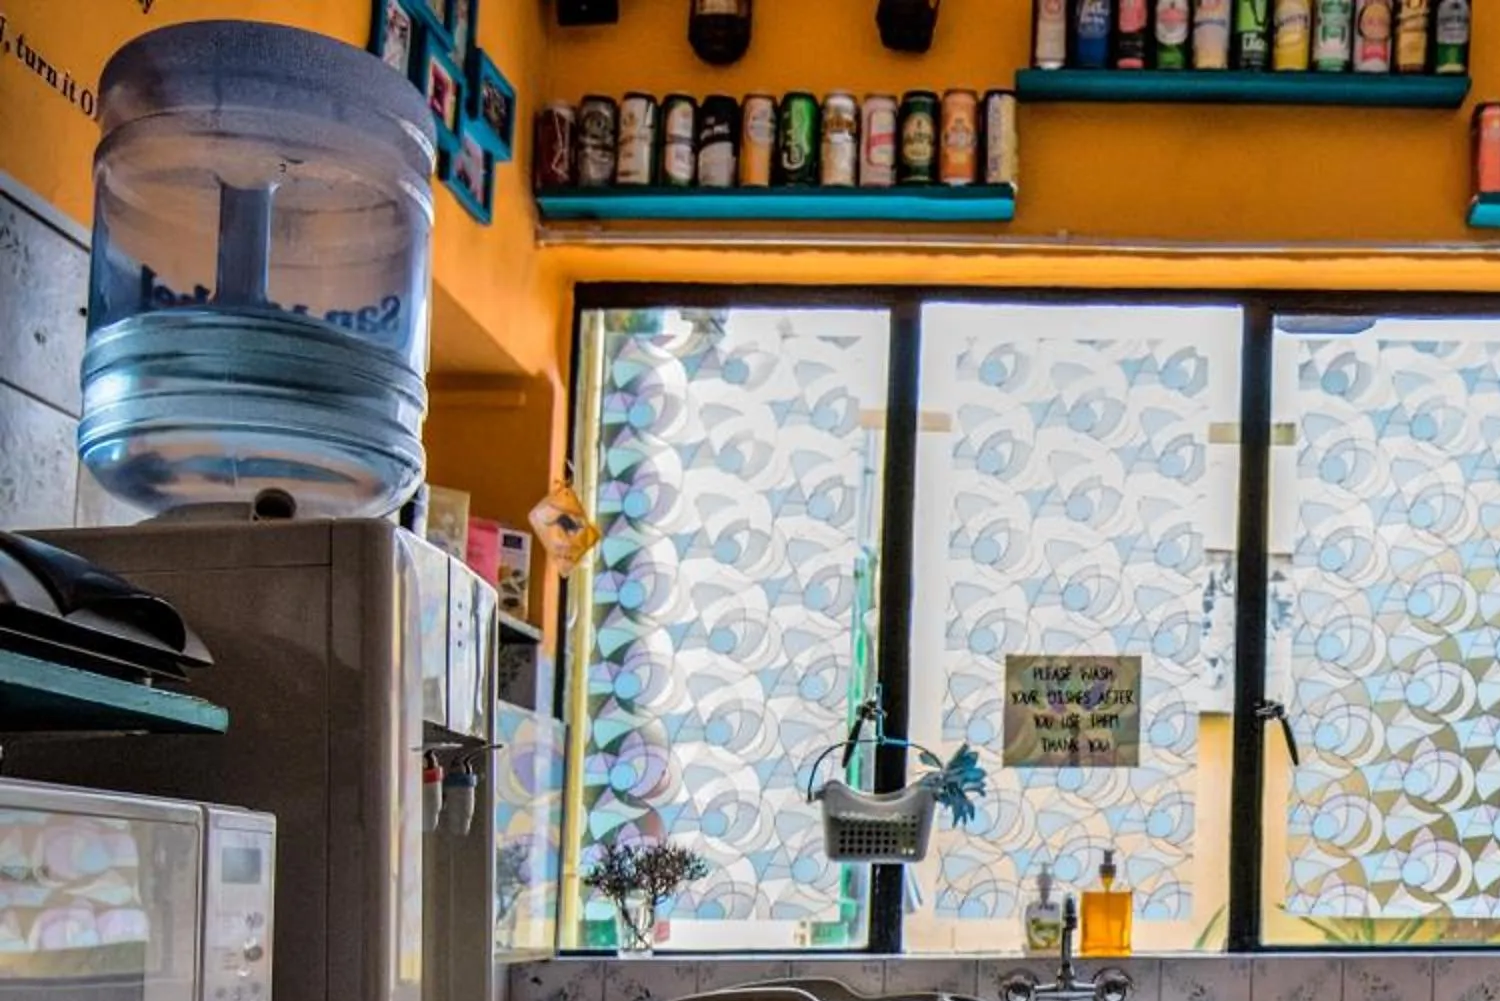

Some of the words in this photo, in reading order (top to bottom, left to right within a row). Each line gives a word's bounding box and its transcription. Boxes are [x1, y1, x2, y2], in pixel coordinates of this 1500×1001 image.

[15, 33, 58, 89] turn
[62, 71, 76, 104] it
[1033, 665, 1072, 681] PLEASE
[1079, 666, 1114, 681] WASH
[1097, 689, 1134, 704] AFTER
[1041, 737, 1079, 753] THANK
